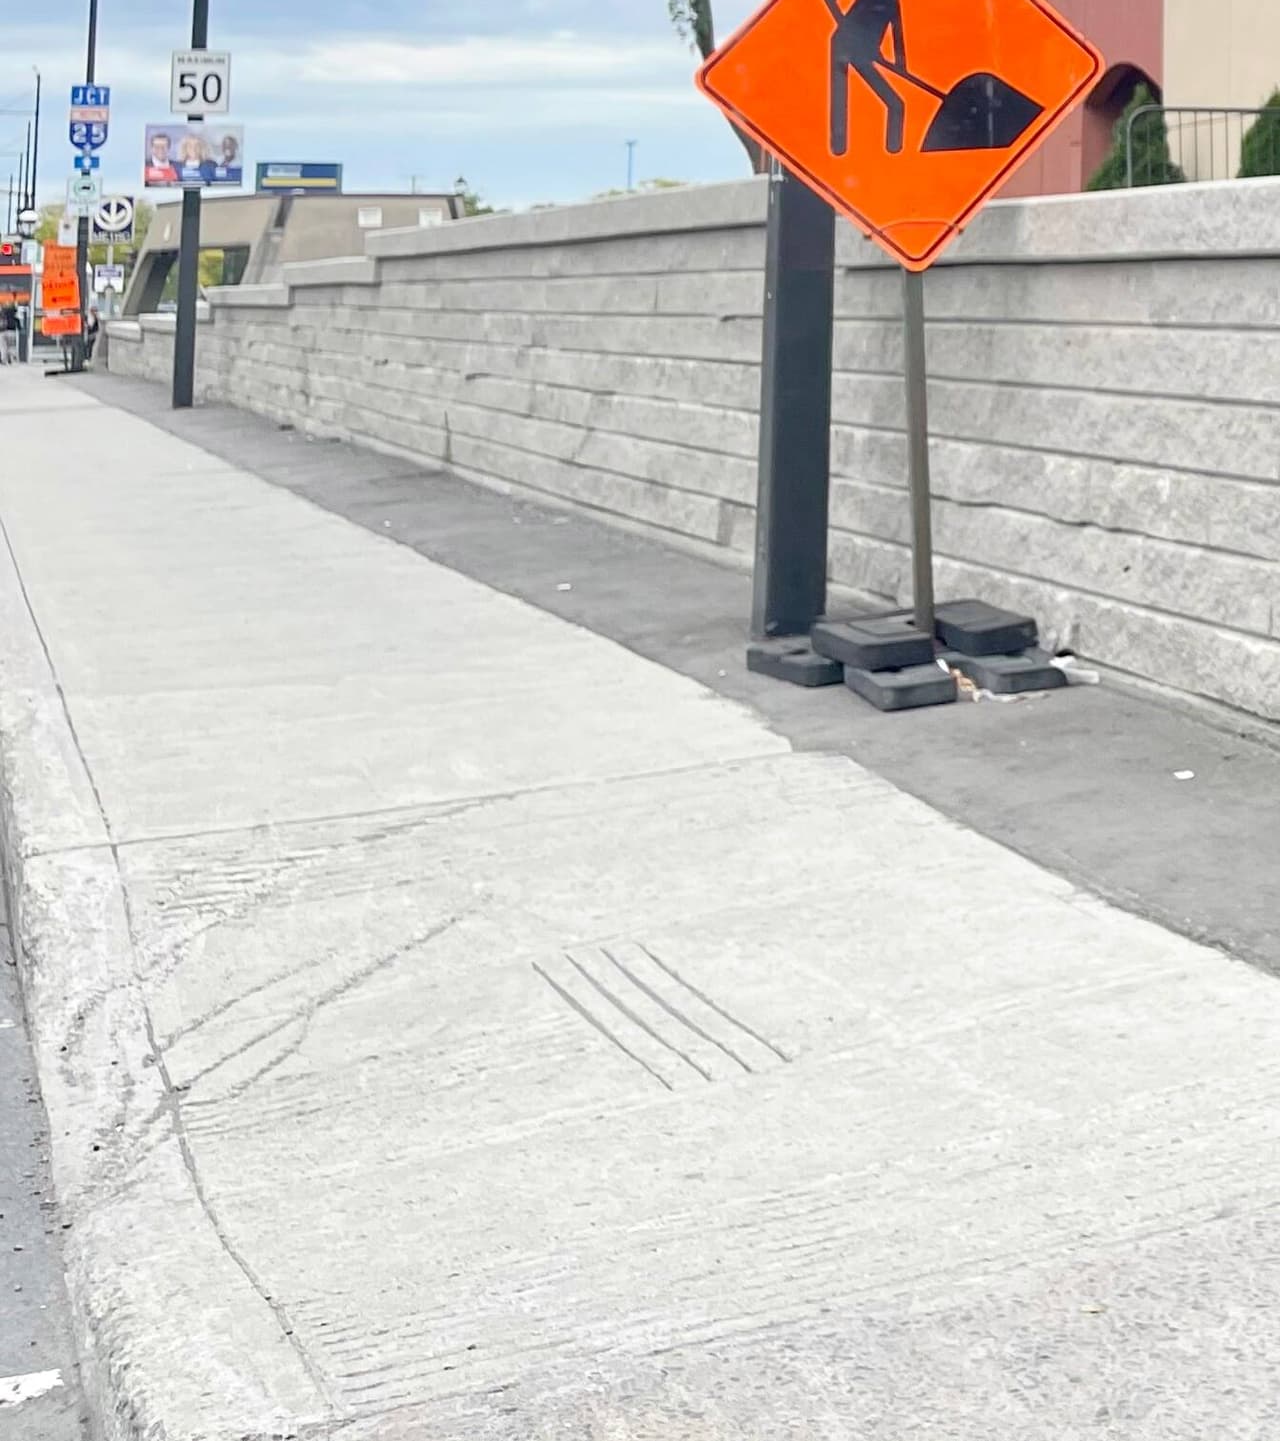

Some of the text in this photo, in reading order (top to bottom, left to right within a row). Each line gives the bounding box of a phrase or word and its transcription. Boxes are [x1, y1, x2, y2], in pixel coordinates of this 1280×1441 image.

[73, 87, 107, 105] JCT
[179, 72, 222, 104] 50
[73, 122, 105, 144] 25
